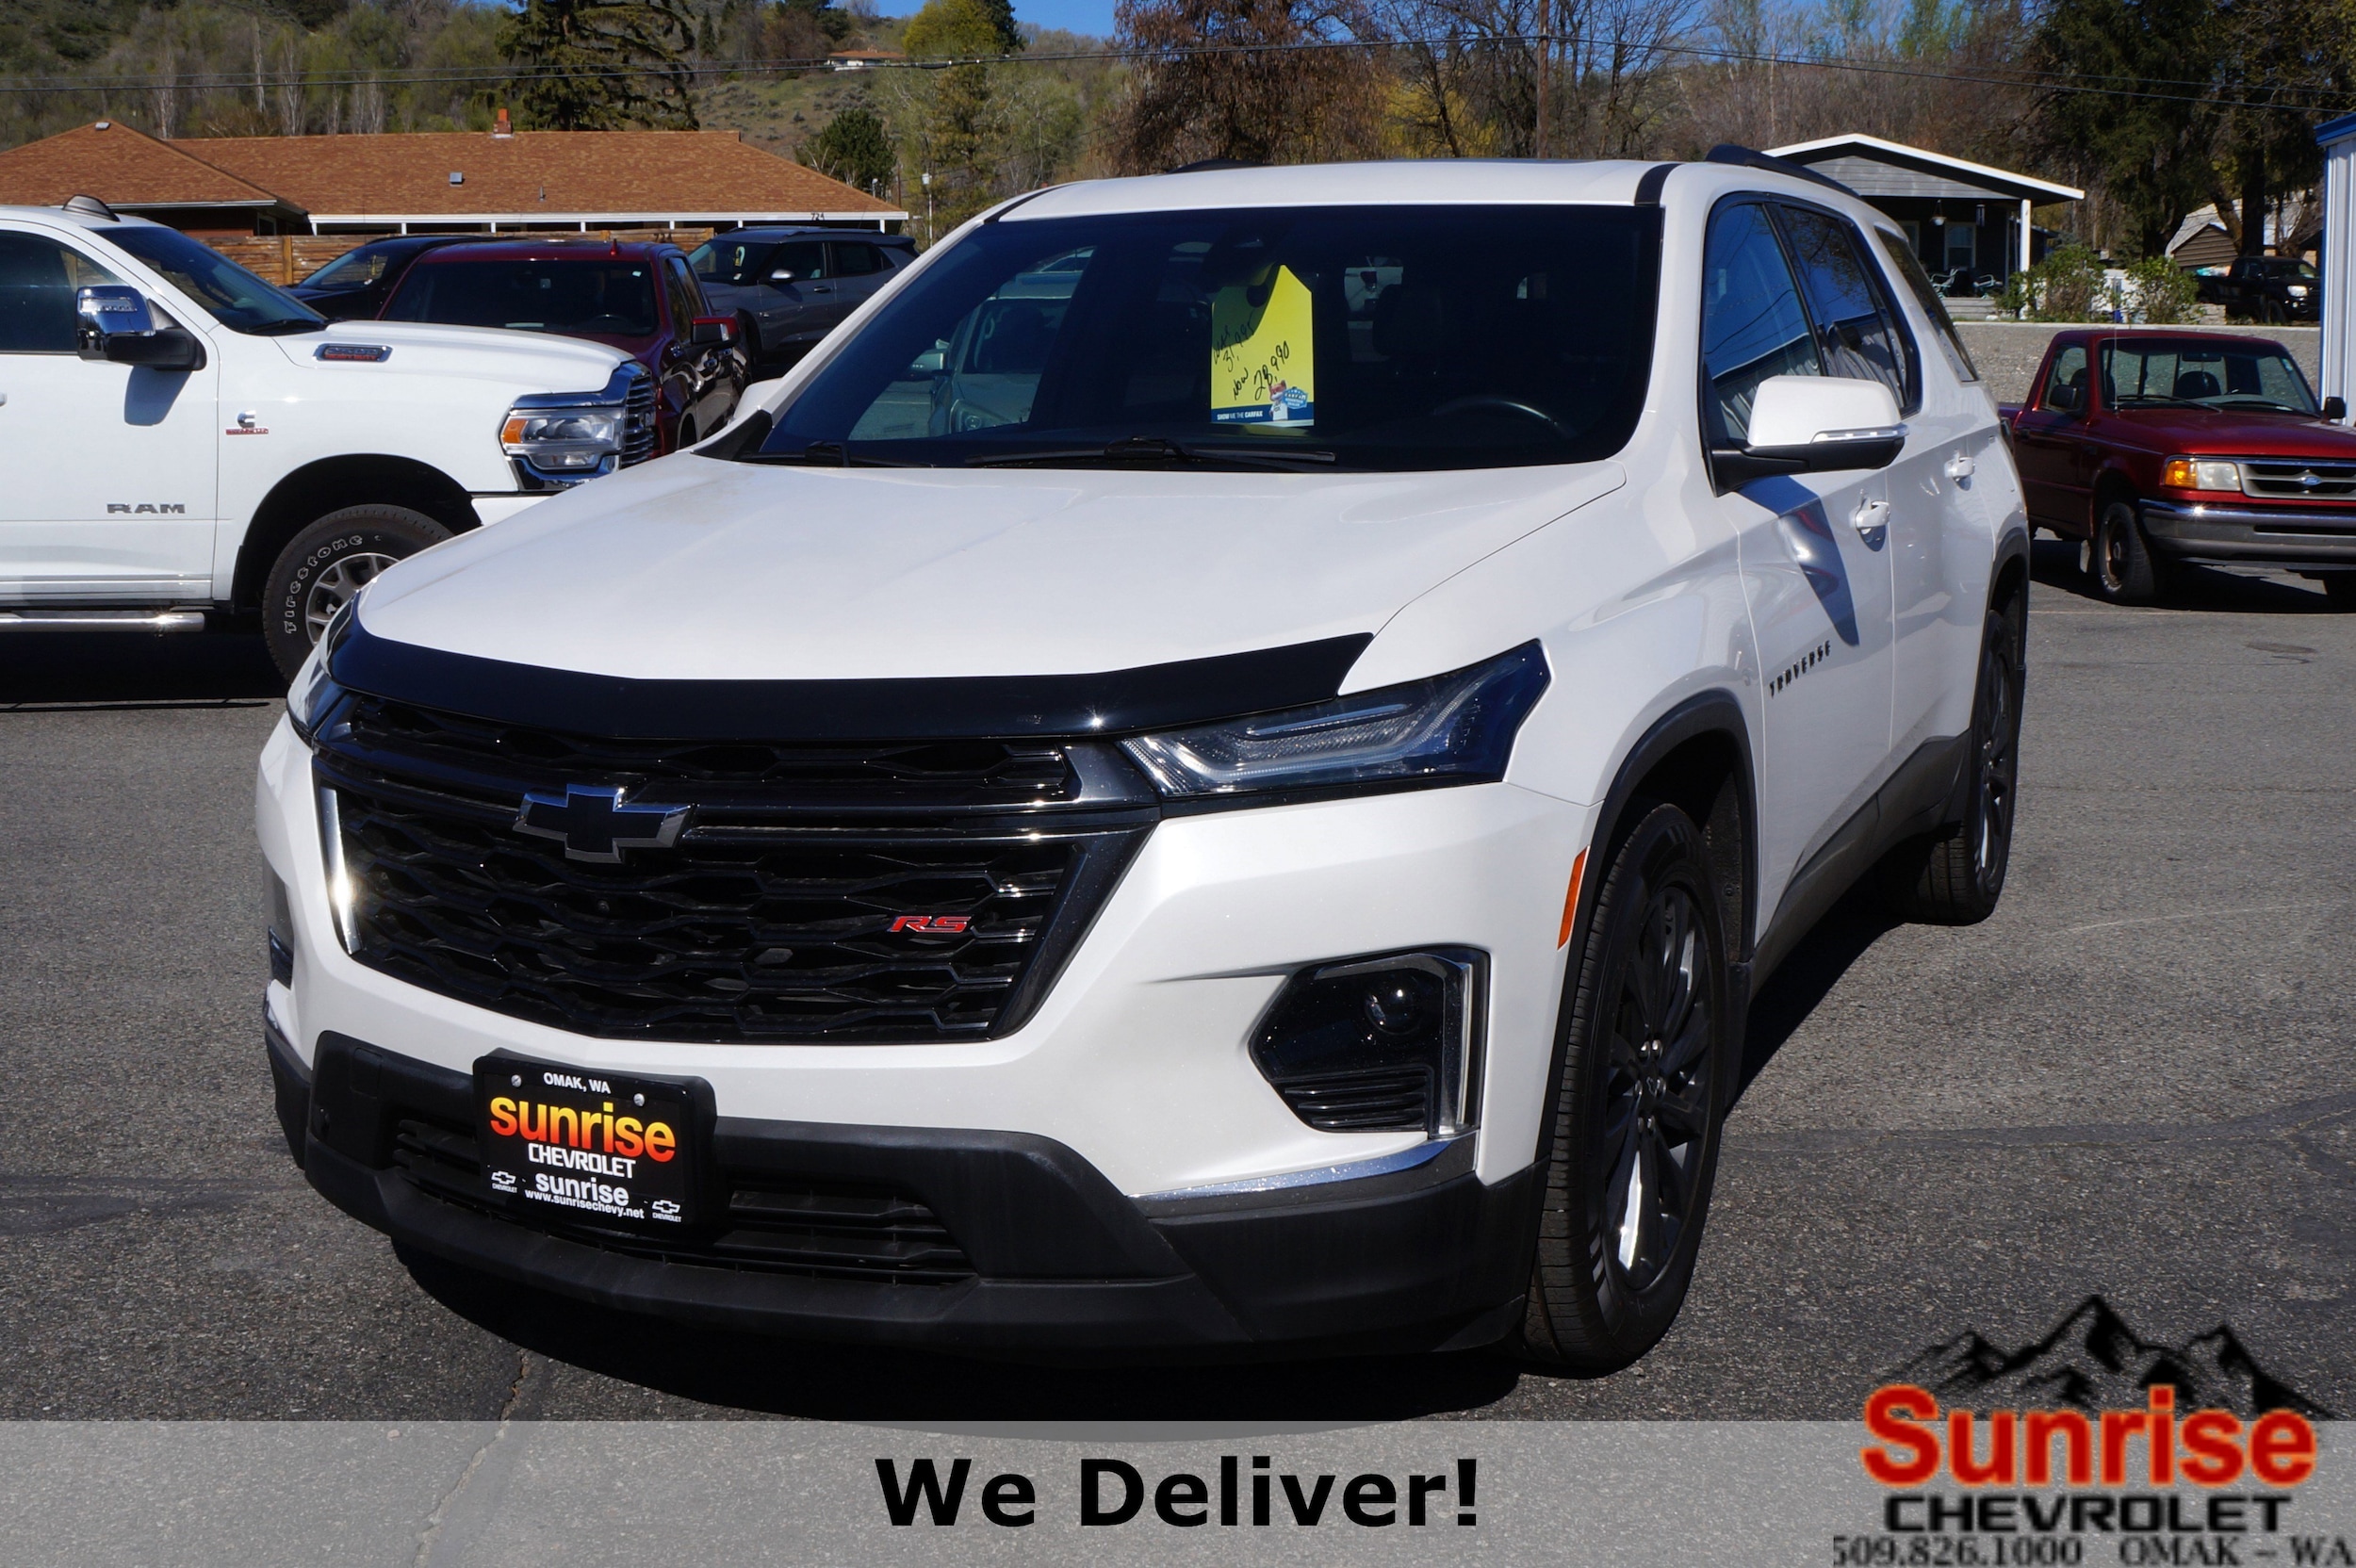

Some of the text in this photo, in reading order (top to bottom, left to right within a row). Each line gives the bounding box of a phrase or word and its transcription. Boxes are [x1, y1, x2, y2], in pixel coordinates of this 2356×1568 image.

[1253, 340, 1290, 401] 28,990
[1244, 410, 1264, 418] CARFAX
[106, 503, 186, 514] RAM
[285, 534, 364, 634] Firestone
[1769, 639, 1831, 699] TRAVERSE
[887, 915, 972, 933] RS
[543, 1071, 612, 1094] OMAK, WA
[489, 1096, 676, 1163] sunrise
[528, 1142, 636, 1179] CHEVROLET
[492, 1183, 517, 1194] CHEVROLET
[524, 1188, 646, 1219] www.sunrisechevy.net
[534, 1172, 630, 1206] sunrise
[652, 1212, 682, 1223] CHEVROLET
